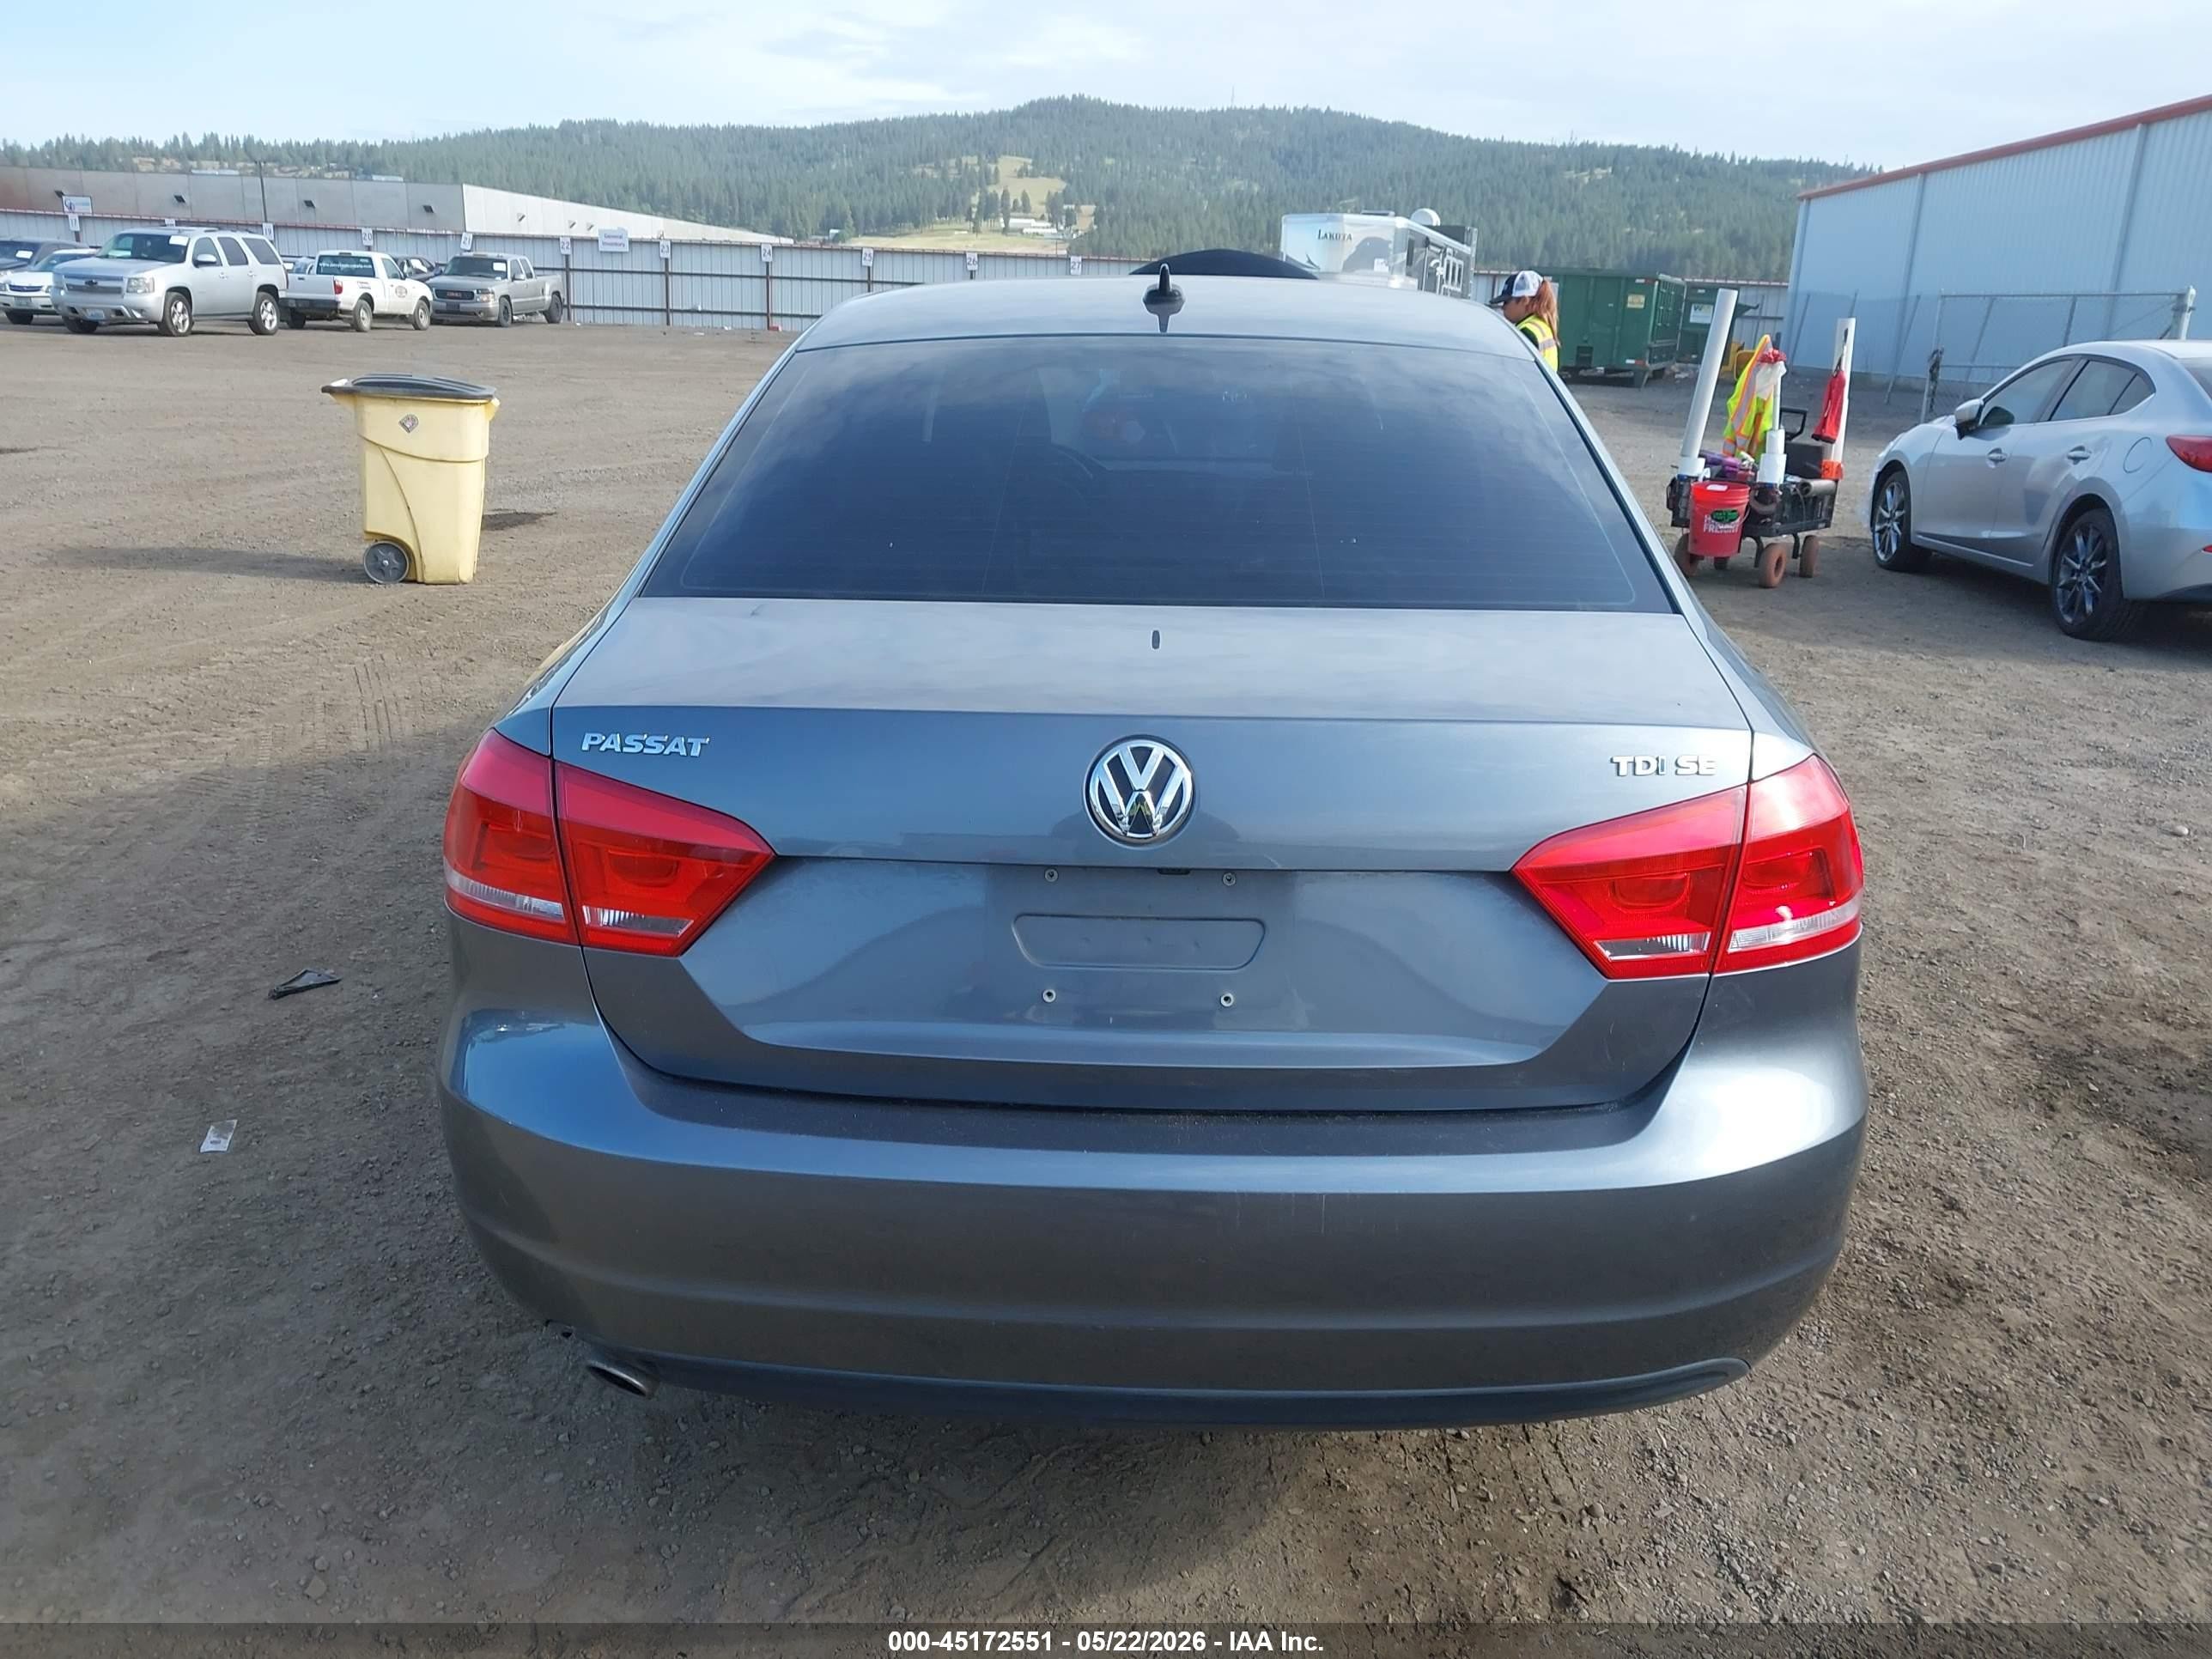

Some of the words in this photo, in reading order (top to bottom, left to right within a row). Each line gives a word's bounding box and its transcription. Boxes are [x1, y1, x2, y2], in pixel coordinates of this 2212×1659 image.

[363, 233, 373, 241] 20
[561, 240, 570, 250] 22
[762, 248, 771, 258] 24
[863, 252, 872, 261] 25
[967, 257, 977, 265] 26
[580, 732, 710, 757] PASSAT
[1610, 756, 1666, 777] TDI
[1675, 755, 1718, 776] SE
